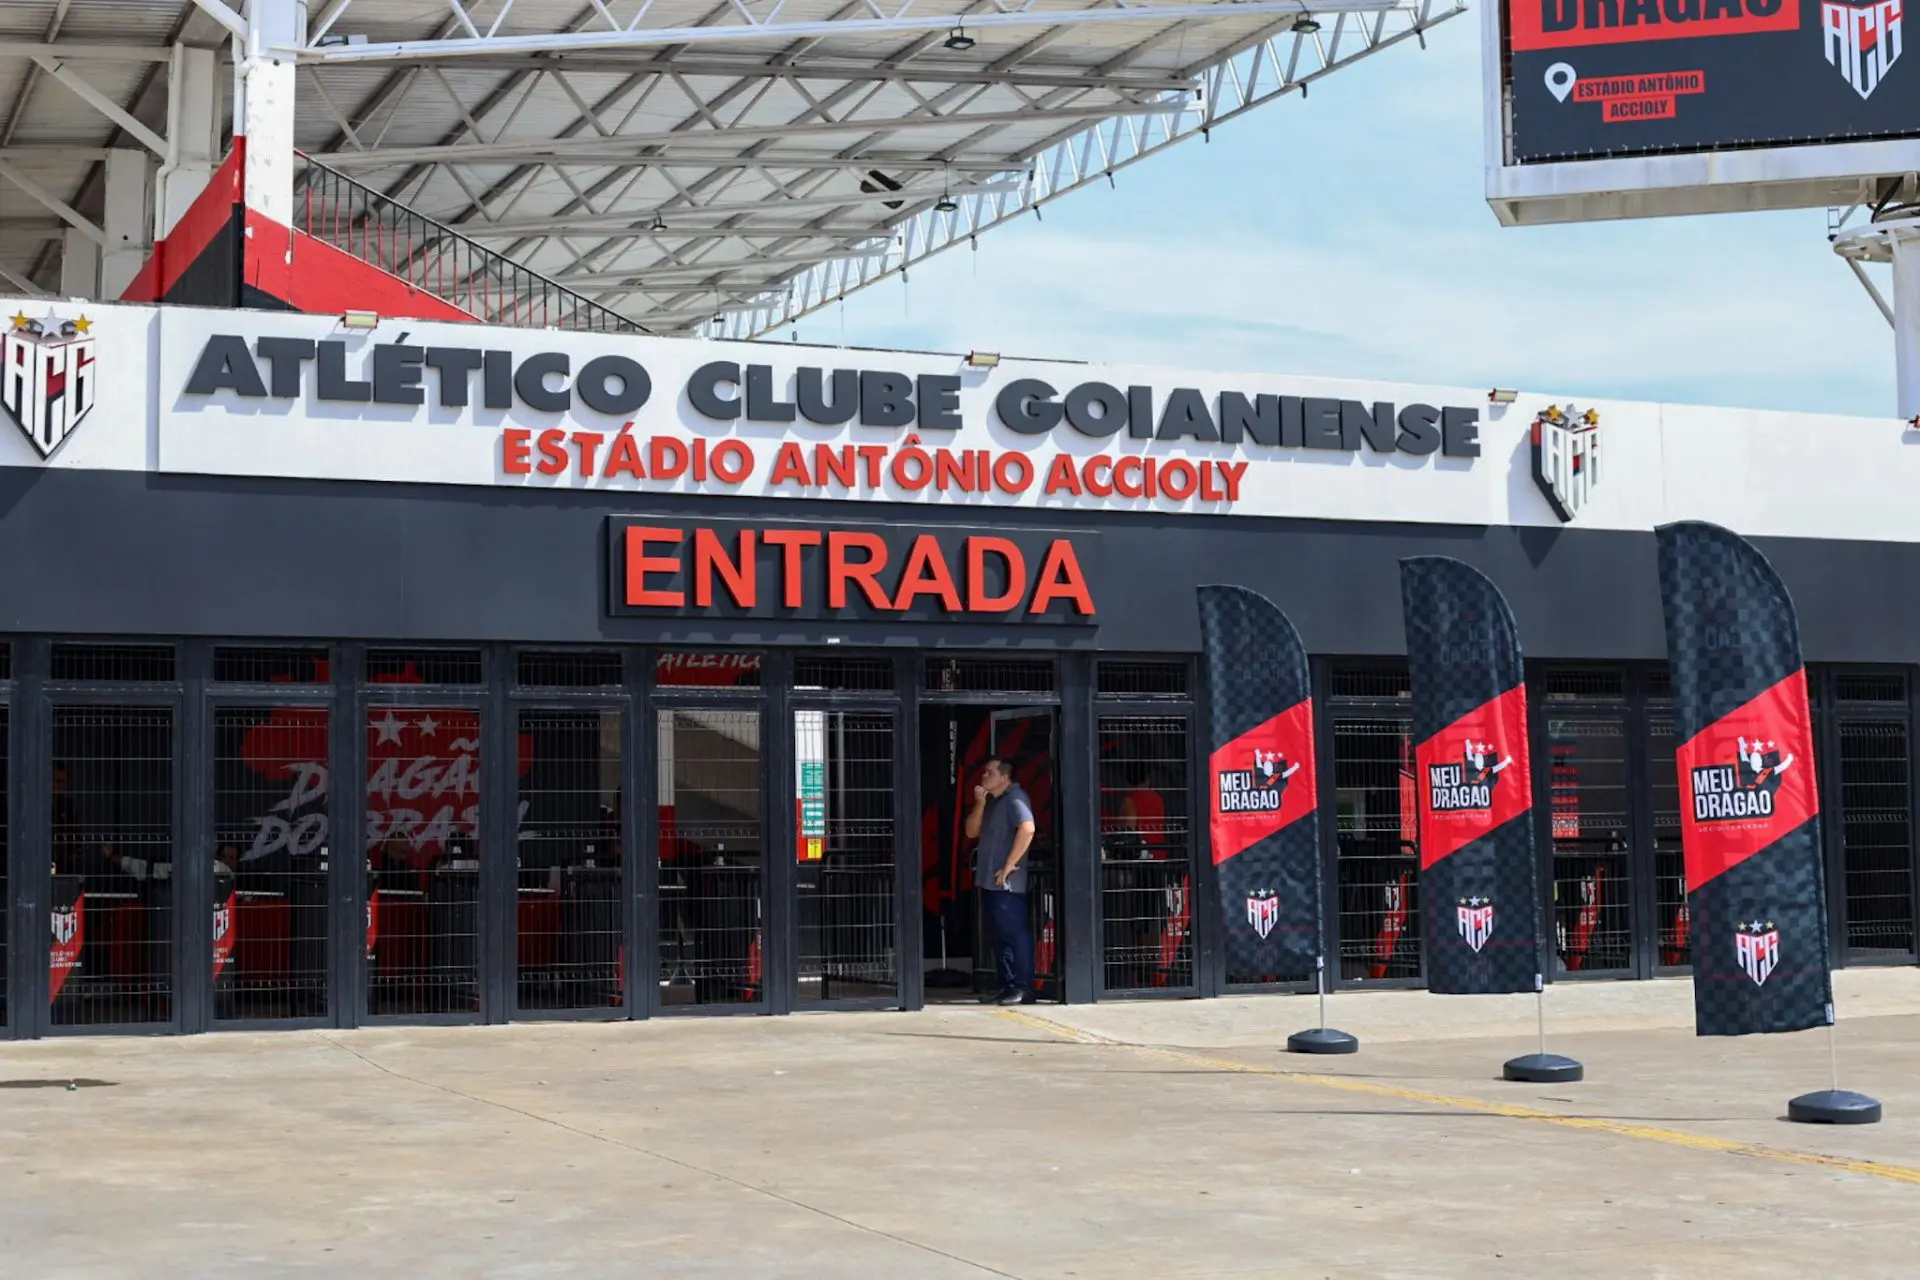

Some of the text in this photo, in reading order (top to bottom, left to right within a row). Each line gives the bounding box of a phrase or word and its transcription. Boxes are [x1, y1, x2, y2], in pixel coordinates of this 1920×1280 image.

[1578, 75, 1698, 97] ESTÁDIO ANTÔNIO
[1610, 100, 1668, 117] ACCIOLY
[184, 332, 1482, 458] ATLÉTICO CLUBE GOIANIENSE
[503, 421, 1249, 501] ESTÁDIO ANTÔNIO ACCIOLY
[625, 526, 1096, 615] ENTRADA
[1220, 772, 1251, 792] MEU
[1430, 766, 1461, 788] MEU
[1693, 768, 1734, 794] MEU
[1221, 790, 1280, 810] DRAGAO
[1432, 785, 1491, 809] DRAGAO
[1696, 790, 1772, 819] DRAGAO
